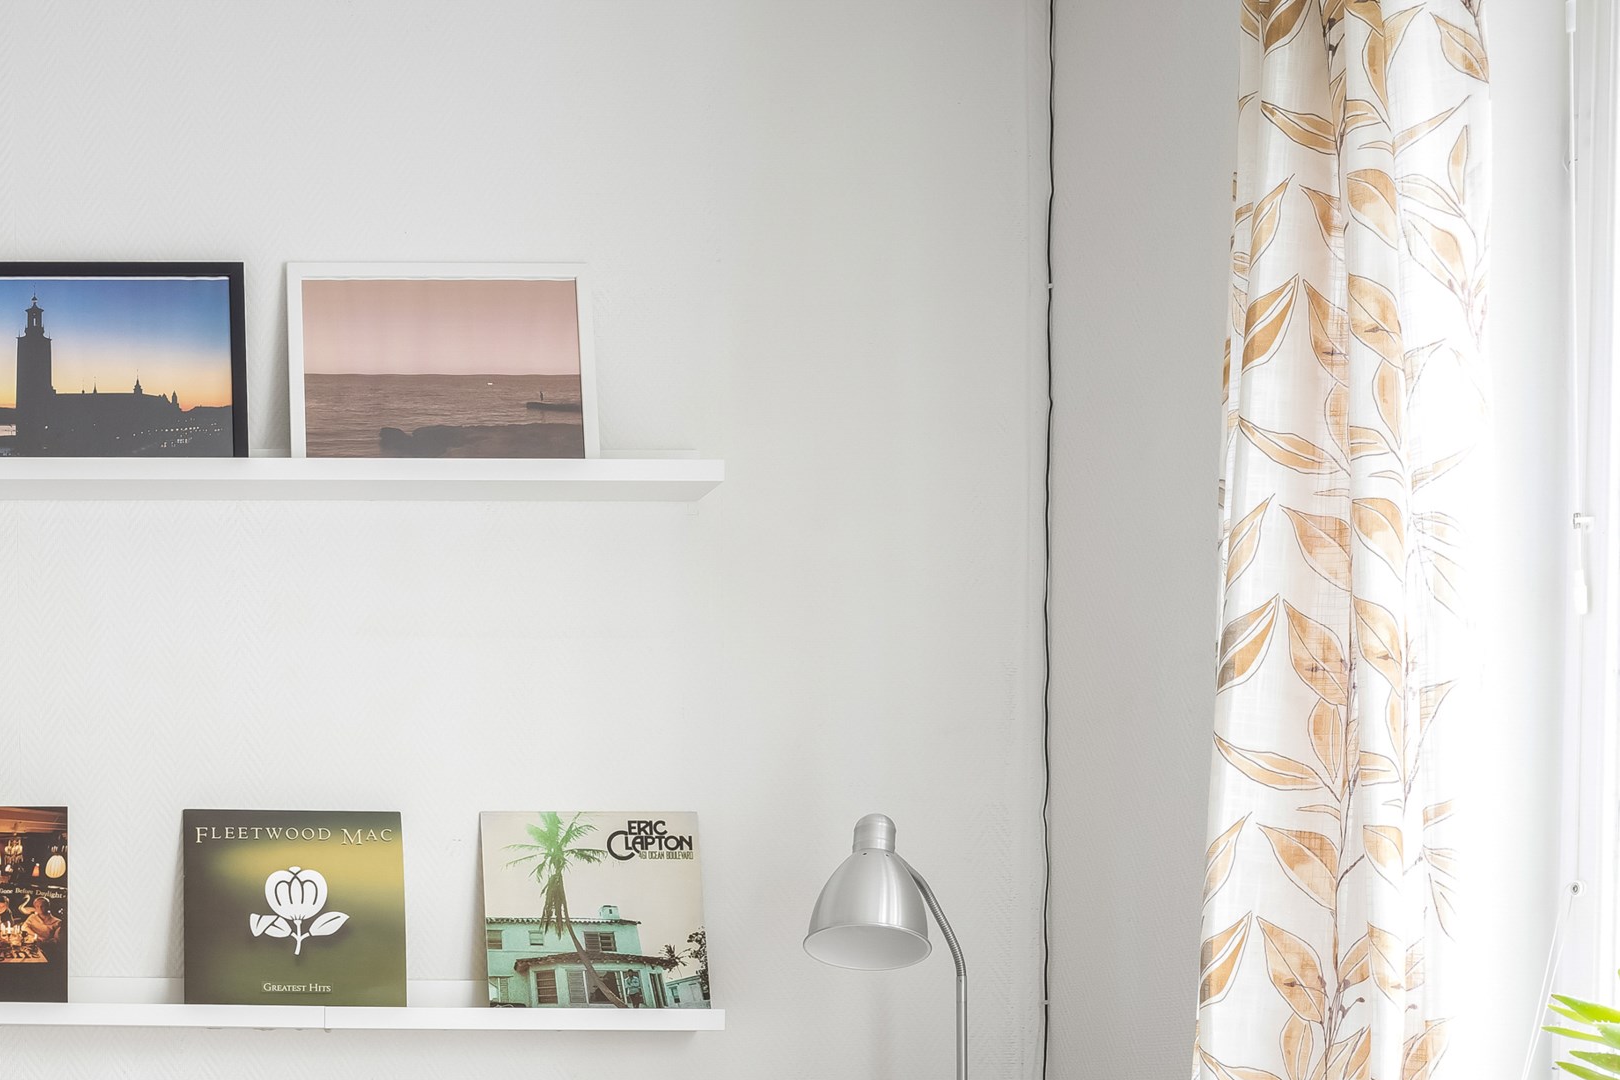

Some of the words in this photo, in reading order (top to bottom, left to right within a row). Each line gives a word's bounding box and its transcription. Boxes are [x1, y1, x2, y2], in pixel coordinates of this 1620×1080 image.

[627, 820, 668, 836] ERIC
[195, 826, 332, 844] FLEETWOOD
[340, 827, 394, 846] MAC
[606, 830, 693, 861] CLAPTON
[648, 850, 665, 860] OCEAN
[666, 850, 694, 860] BOULEVARD
[15, 887, 33, 895] Before
[36, 889, 63, 899] Daylight
[263, 982, 307, 992] GREATEST
[309, 983, 332, 992] HITS
